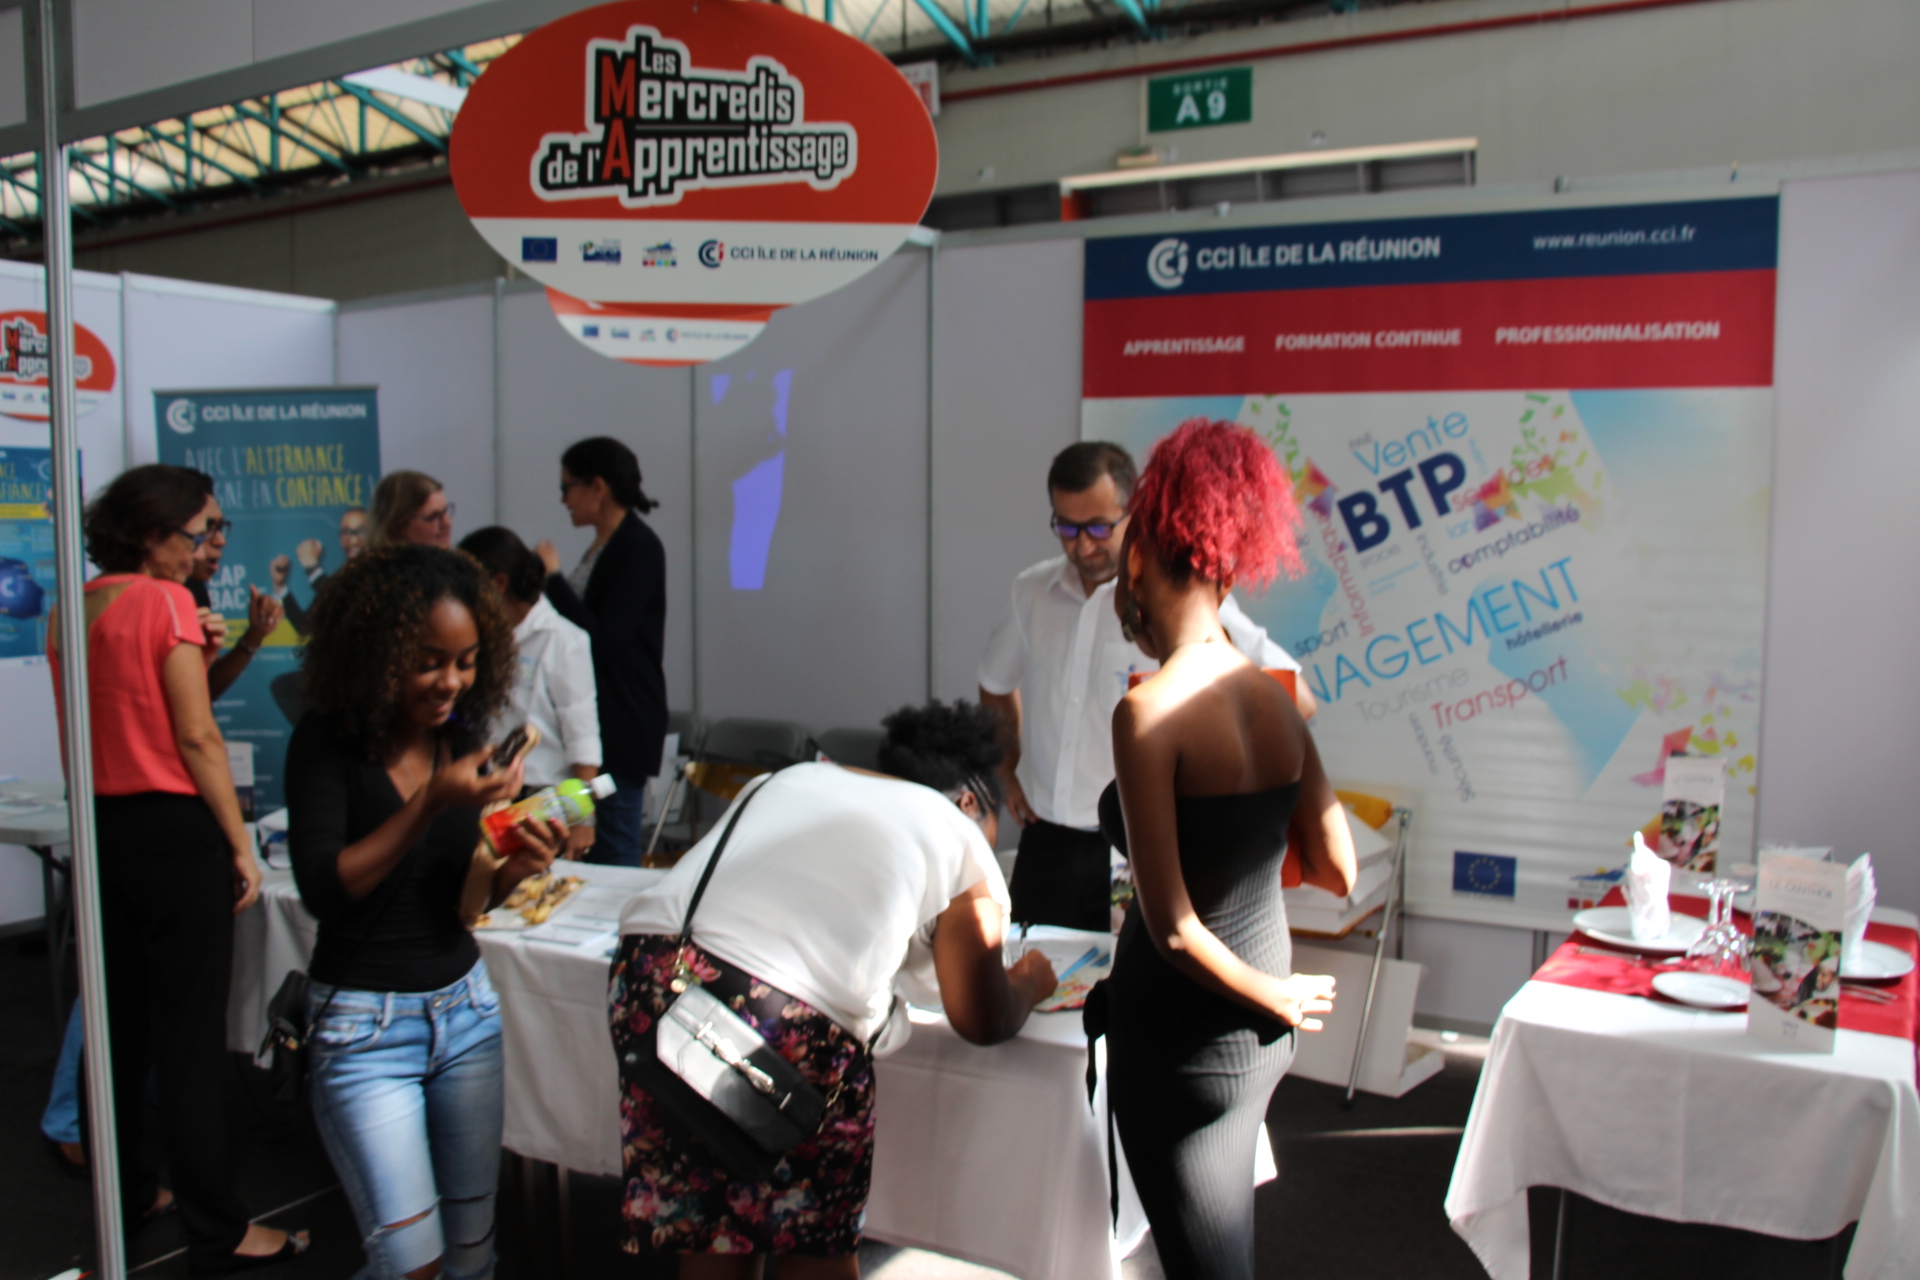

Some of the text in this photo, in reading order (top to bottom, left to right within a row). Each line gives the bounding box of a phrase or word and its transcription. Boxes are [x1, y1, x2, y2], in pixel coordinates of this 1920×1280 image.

[641, 41, 676, 74] Les
[601, 55, 792, 121] Mercredis
[547, 147, 578, 184] de
[730, 247, 754, 260] CCI
[780, 248, 797, 261] DE
[800, 248, 817, 261] LA
[820, 247, 879, 262] RÉUNION
[1196, 248, 1234, 271] CCI
[1276, 244, 1304, 267] DE
[1308, 242, 1336, 265] LA
[1340, 236, 1441, 263] RÉUNION
[1532, 224, 1696, 250] www.reunion.cci.fr
[1123, 336, 1245, 356] APPRENTISSAGE
[1275, 328, 1461, 351] FORMATION CONTINUE
[1495, 321, 1721, 345] PROFESSIONNALISATION
[202, 405, 230, 422] CCI
[257, 405, 276, 421] DE
[279, 405, 298, 420] LA
[300, 402, 367, 420] RÉUNION
[1353, 412, 1468, 476] Vente
[276, 474, 362, 508] CONFIANCE
[1337, 452, 1466, 554] BTP
[1449, 502, 1581, 574] comptabilité
[1295, 617, 1349, 657] sport
[1310, 556, 1579, 704] NAGEMENT
[1504, 611, 1584, 650] hôtellerie
[1356, 667, 1470, 723] Tourisme
[1430, 654, 1568, 730] Transport
